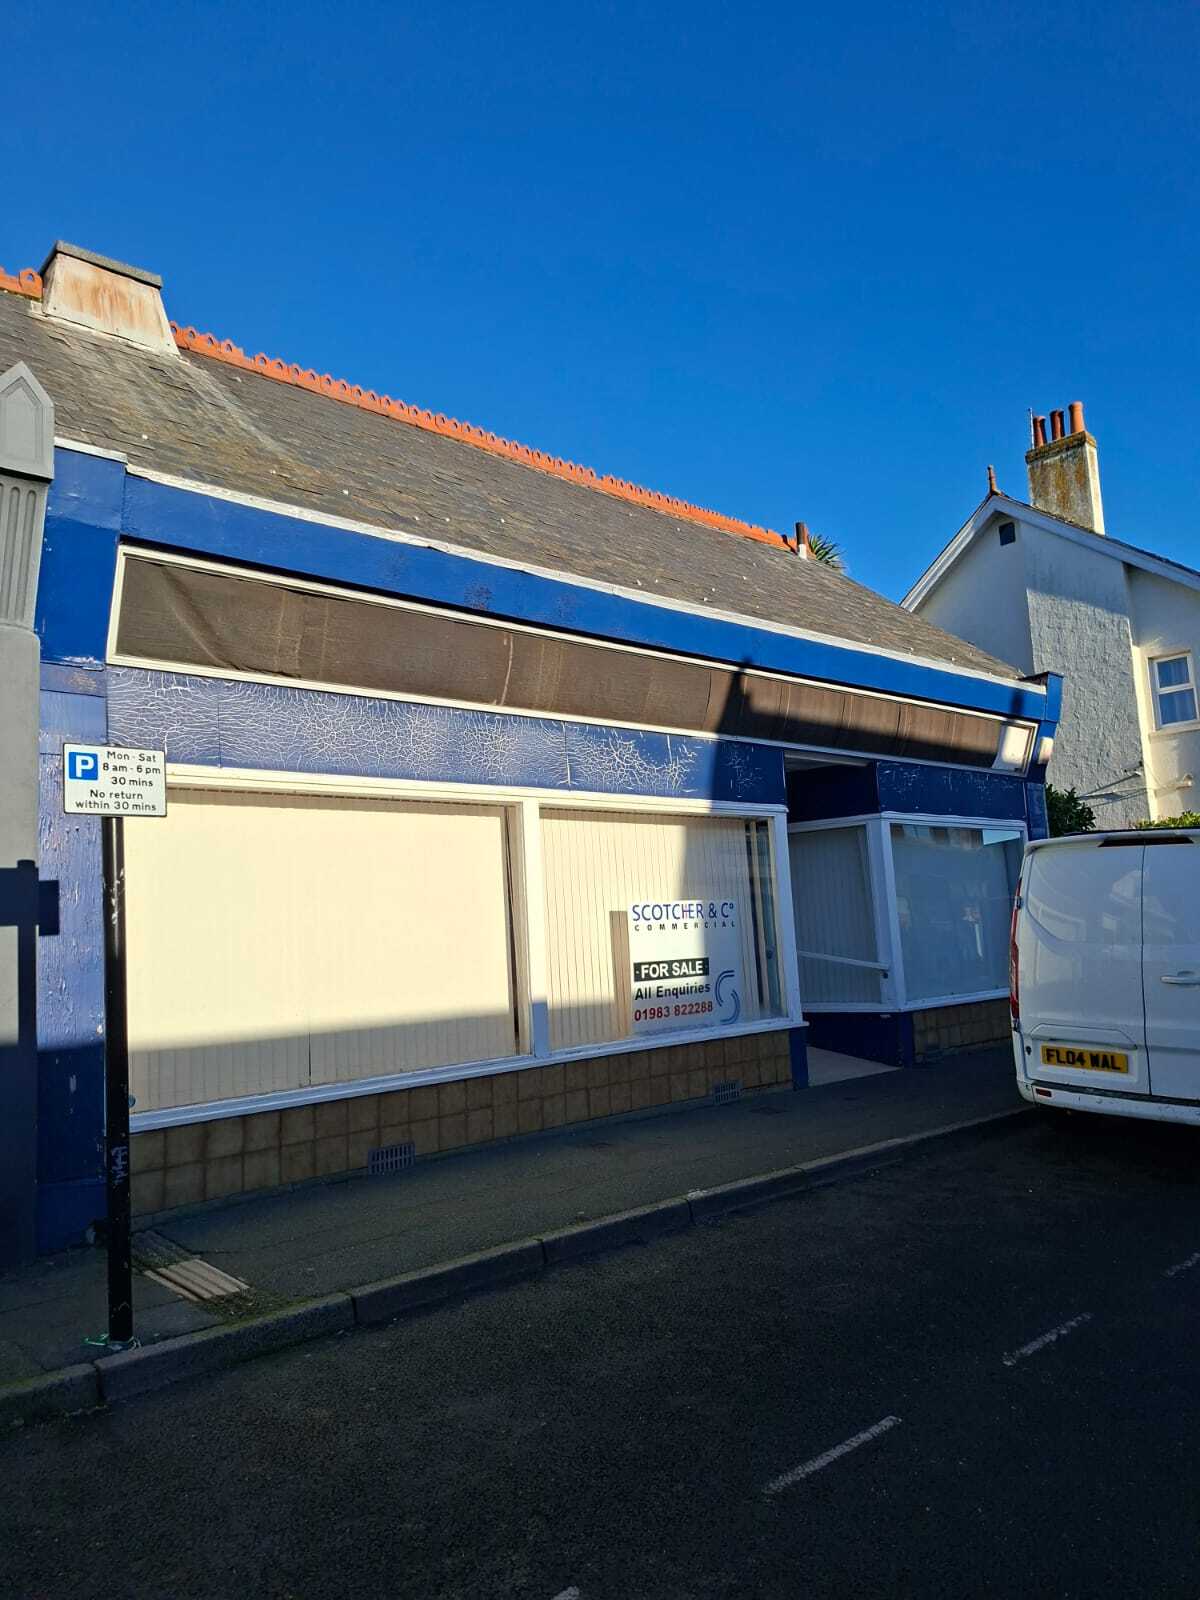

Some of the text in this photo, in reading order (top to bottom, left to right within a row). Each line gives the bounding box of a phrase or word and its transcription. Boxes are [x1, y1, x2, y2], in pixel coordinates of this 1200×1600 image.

[106, 751, 130, 760] Mon
[138, 753, 156, 762] Sat
[75, 754, 95, 778] P
[102, 762, 110, 771] 8
[136, 765, 143, 774] 6
[111, 777, 153, 787] 30 mins
[90, 789, 143, 799] No return
[75, 799, 157, 811] within 30 mins
[632, 903, 705, 921] SCOTCHER
[708, 902, 717, 918] &
[634, 921, 735, 932] COMMERCIAL
[641, 961, 703, 979] FOR SALE
[634, 983, 711, 1000] All Enquiries
[634, 1001, 713, 1021] 01983 822288
